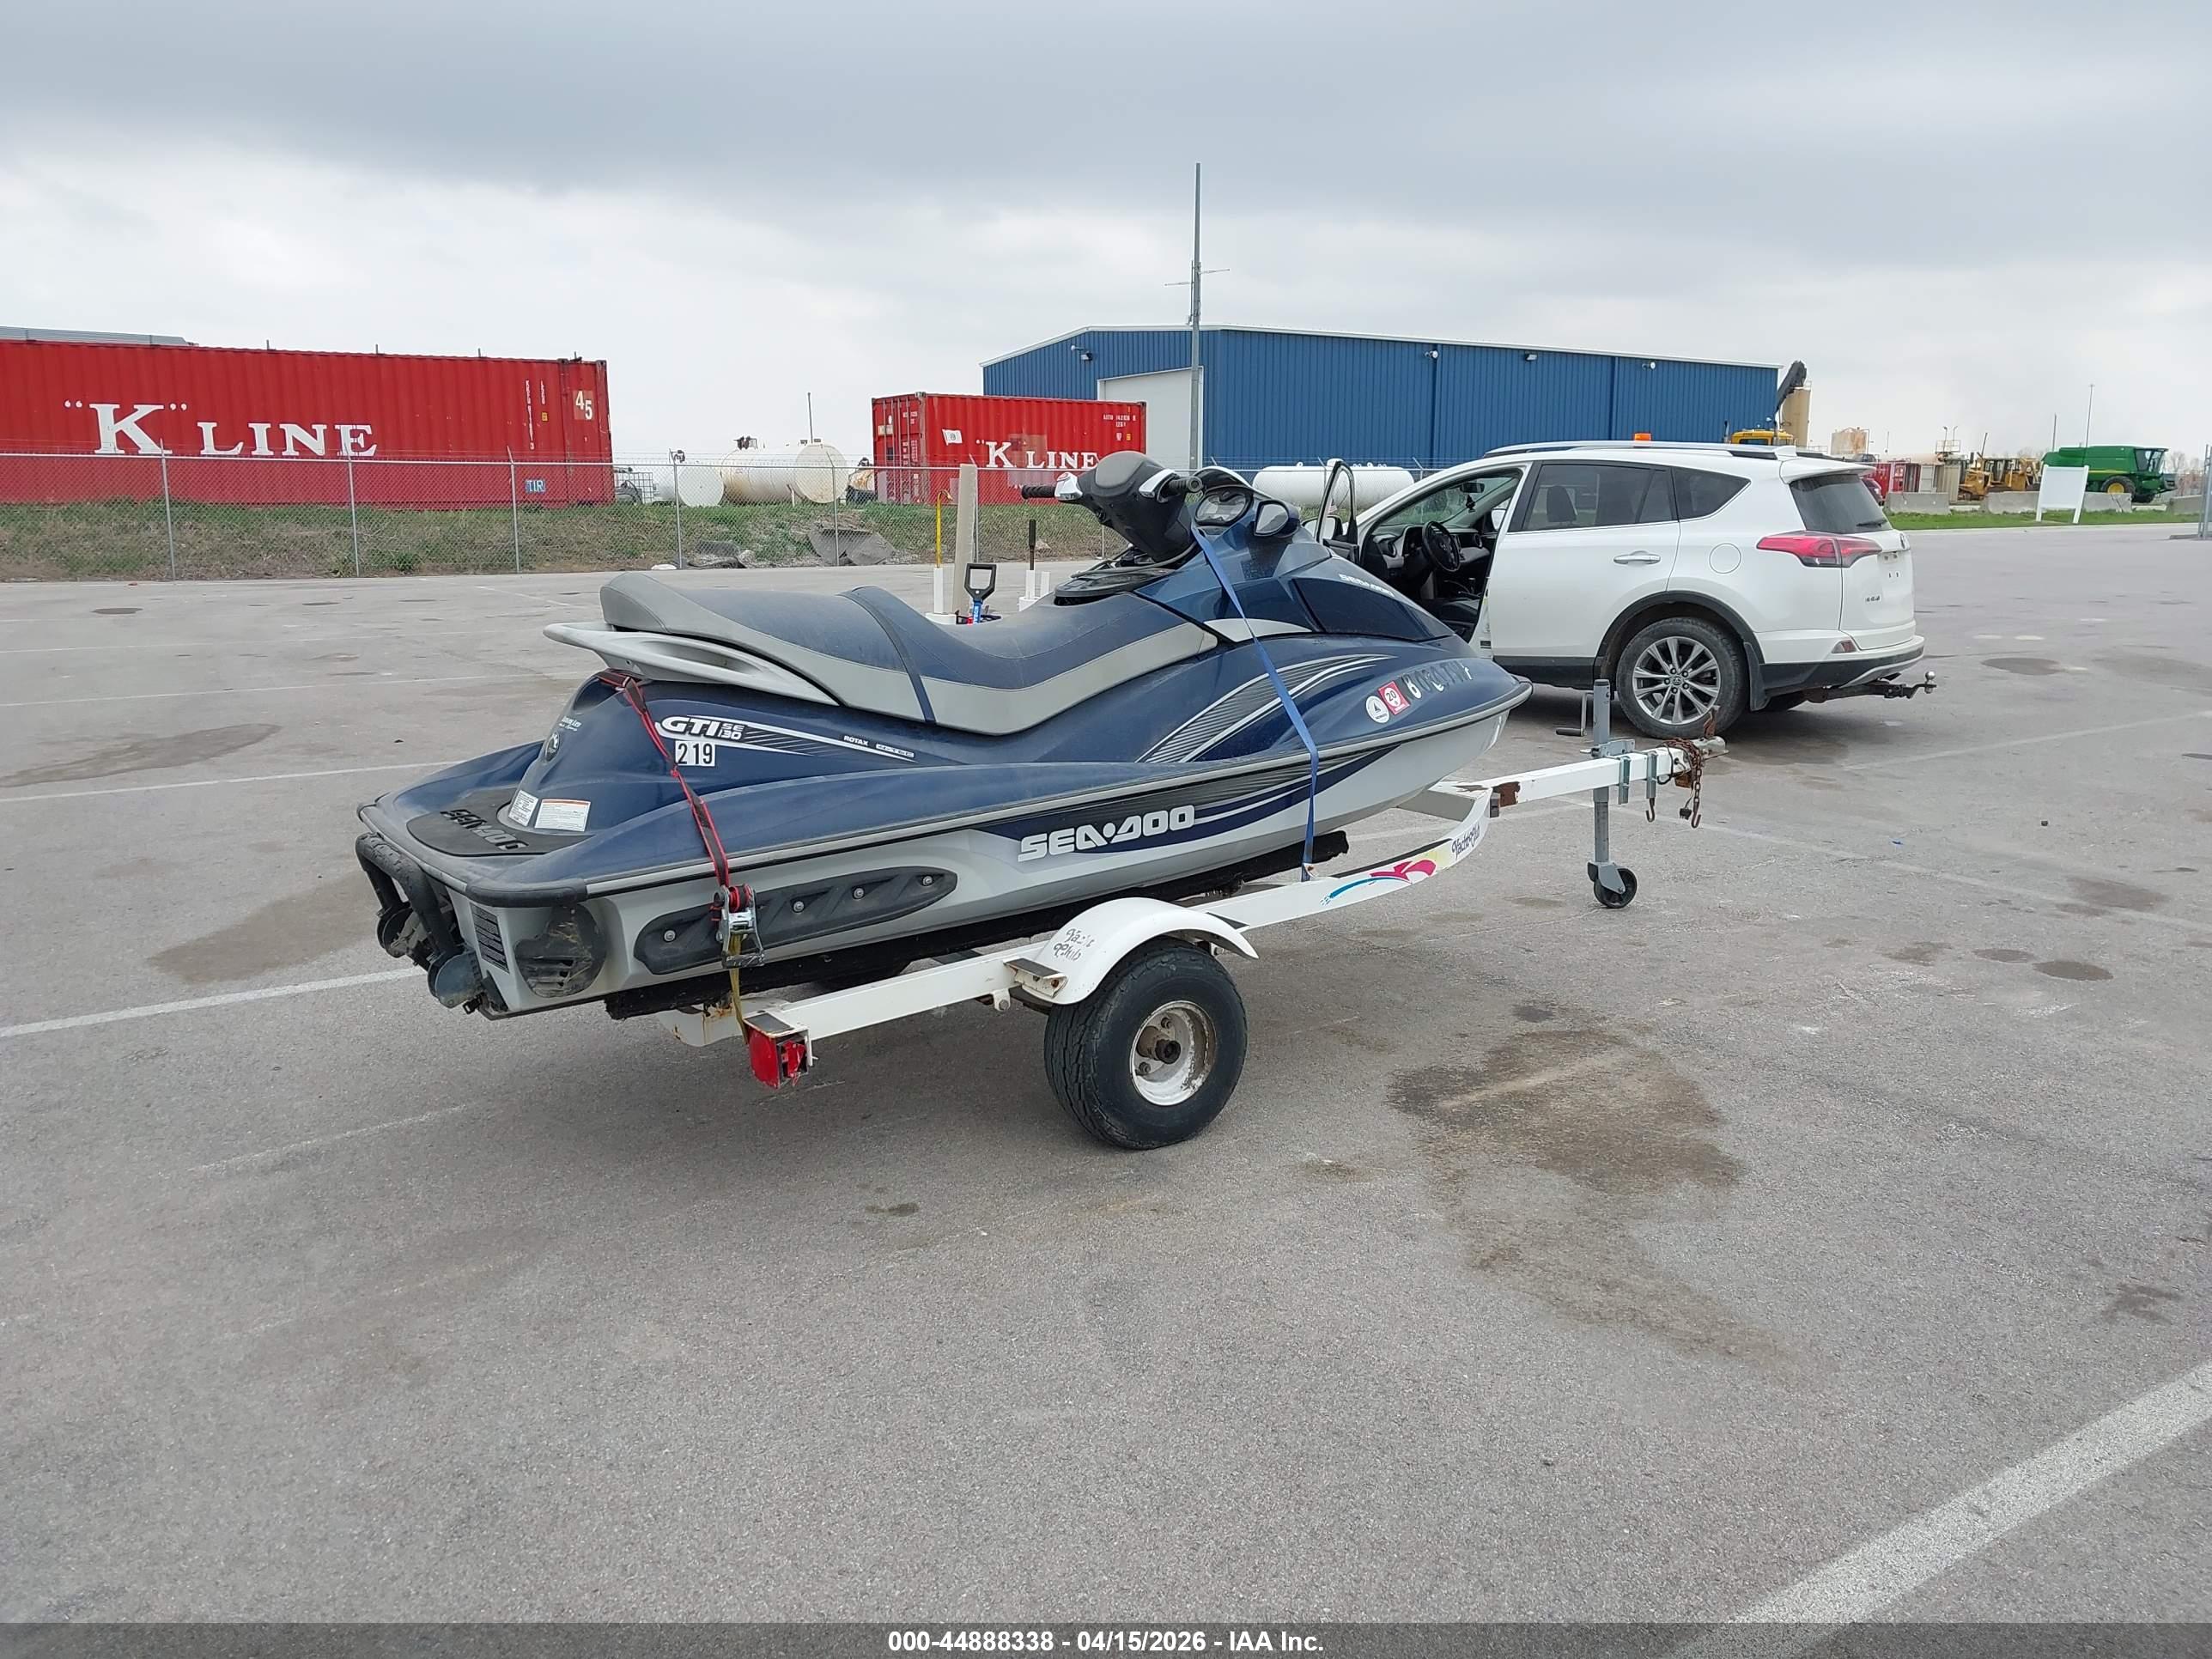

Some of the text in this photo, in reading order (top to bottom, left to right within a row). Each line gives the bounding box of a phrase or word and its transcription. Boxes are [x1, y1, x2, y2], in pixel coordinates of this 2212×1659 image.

[575, 391, 592, 420] 45
[197, 421, 378, 457] LINE
[1026, 451, 1098, 469] LINE
[527, 479, 544, 492] TIR
[1385, 690, 1397, 702] 20
[661, 716, 745, 738] GTI SE
[843, 735, 869, 746] ROTAX
[678, 743, 713, 765] 219
